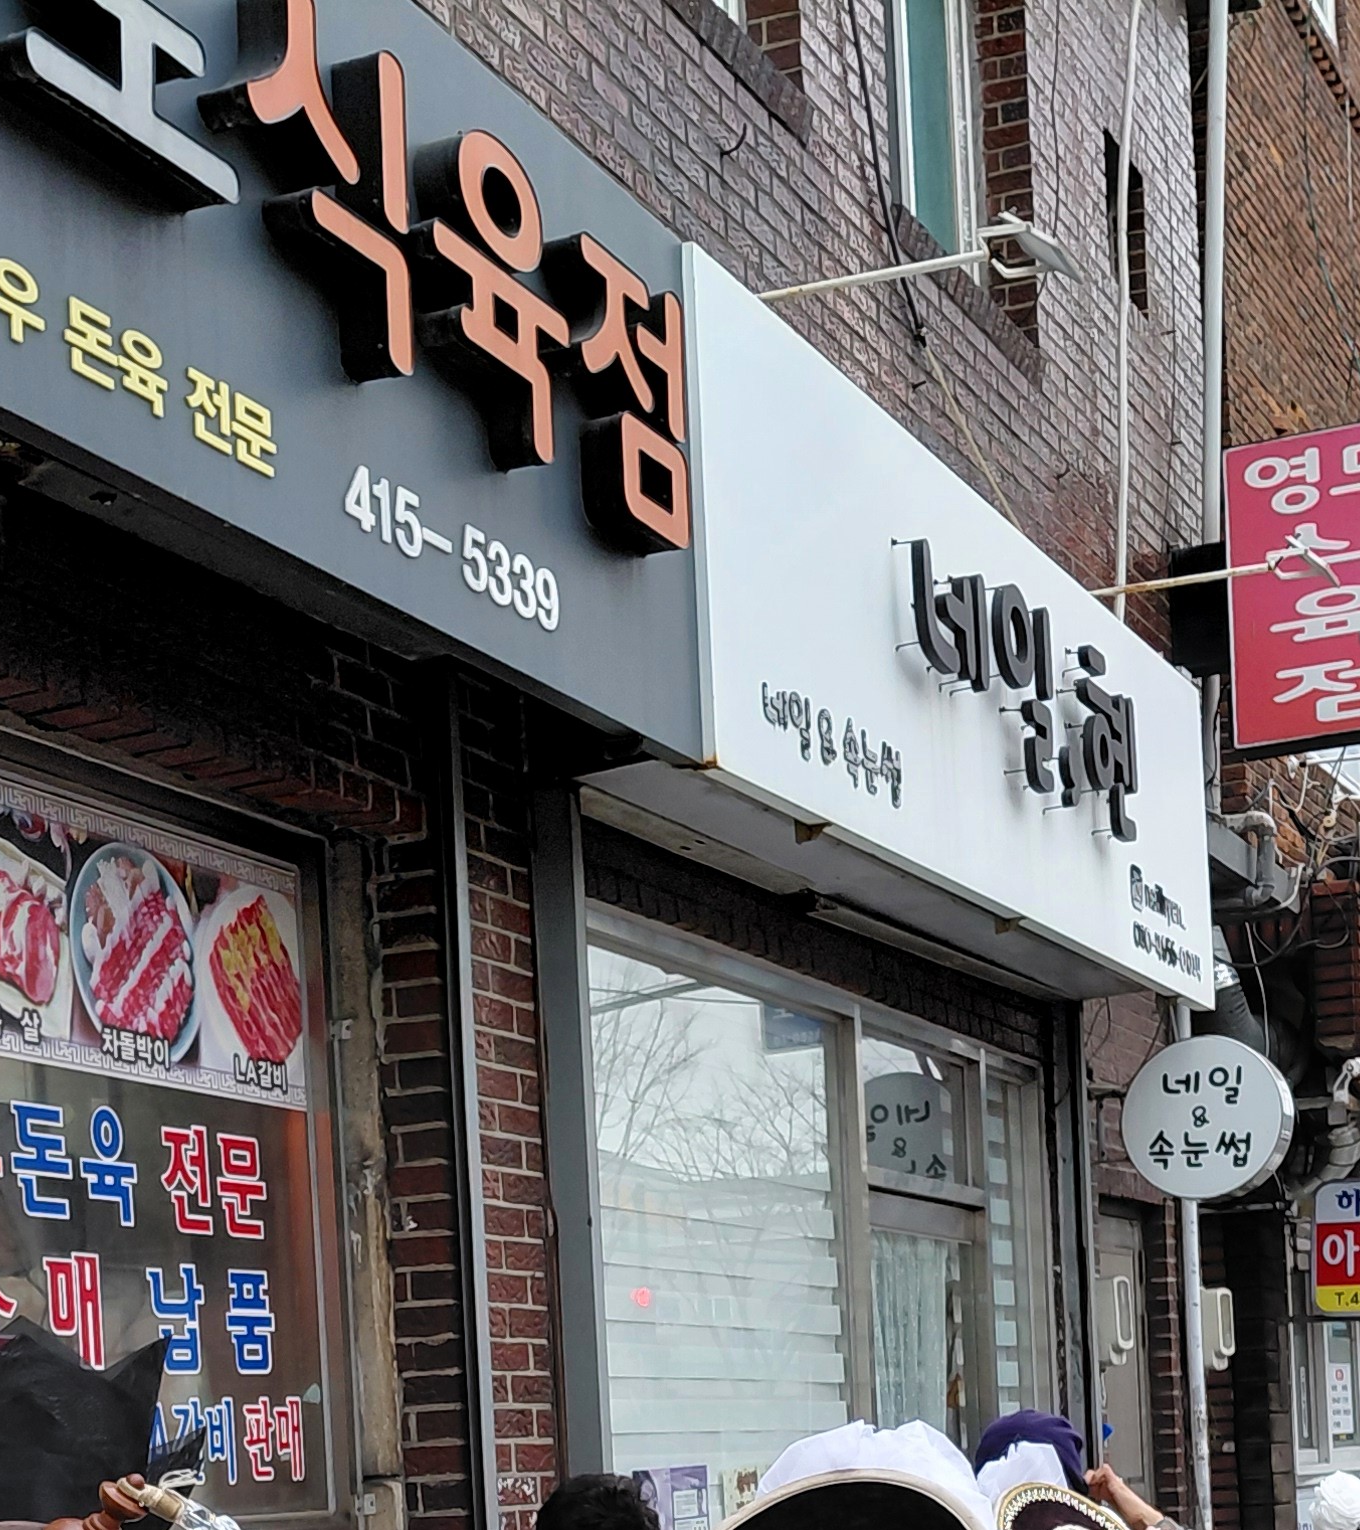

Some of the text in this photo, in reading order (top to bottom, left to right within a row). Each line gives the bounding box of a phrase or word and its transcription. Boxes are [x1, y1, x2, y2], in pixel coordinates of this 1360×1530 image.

[65, 297, 168, 418] 돈육
[185, 367, 278, 477] 전문
[761, 682, 811, 762] 네일
[818, 709, 837, 766] &
[101, 1027, 170, 1069] 차돌박이
[234, 1054, 288, 1091] LA갈비
[1161, 1064, 1245, 1105] 네일
[1191, 1106, 1210, 1128] &
[1148, 1131, 1252, 1170] 속눈썹
[161, 1124, 267, 1239] 전문
[243, 1396, 304, 1482] 판매
